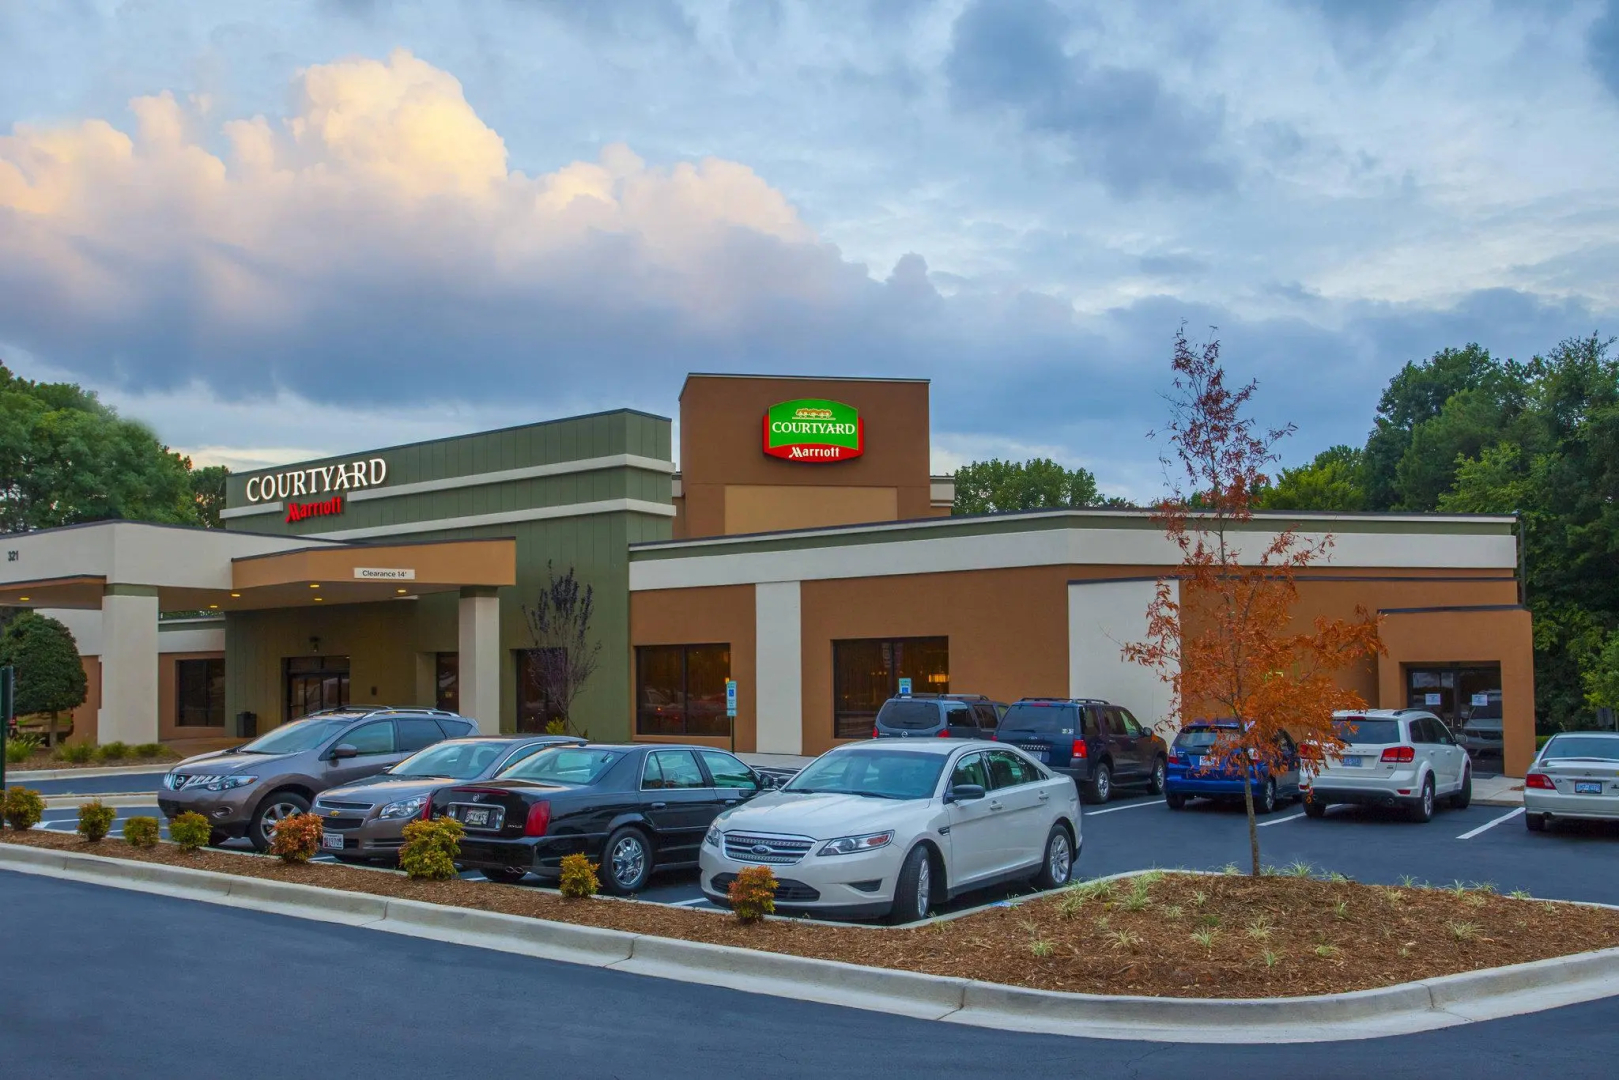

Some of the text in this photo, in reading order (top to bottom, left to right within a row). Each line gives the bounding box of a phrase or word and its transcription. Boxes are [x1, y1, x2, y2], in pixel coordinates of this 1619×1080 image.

[772, 422, 855, 434] COURTYARD
[788, 447, 839, 458] Marriott
[246, 458, 386, 501] COURTYARD
[285, 496, 342, 523] Marriott
